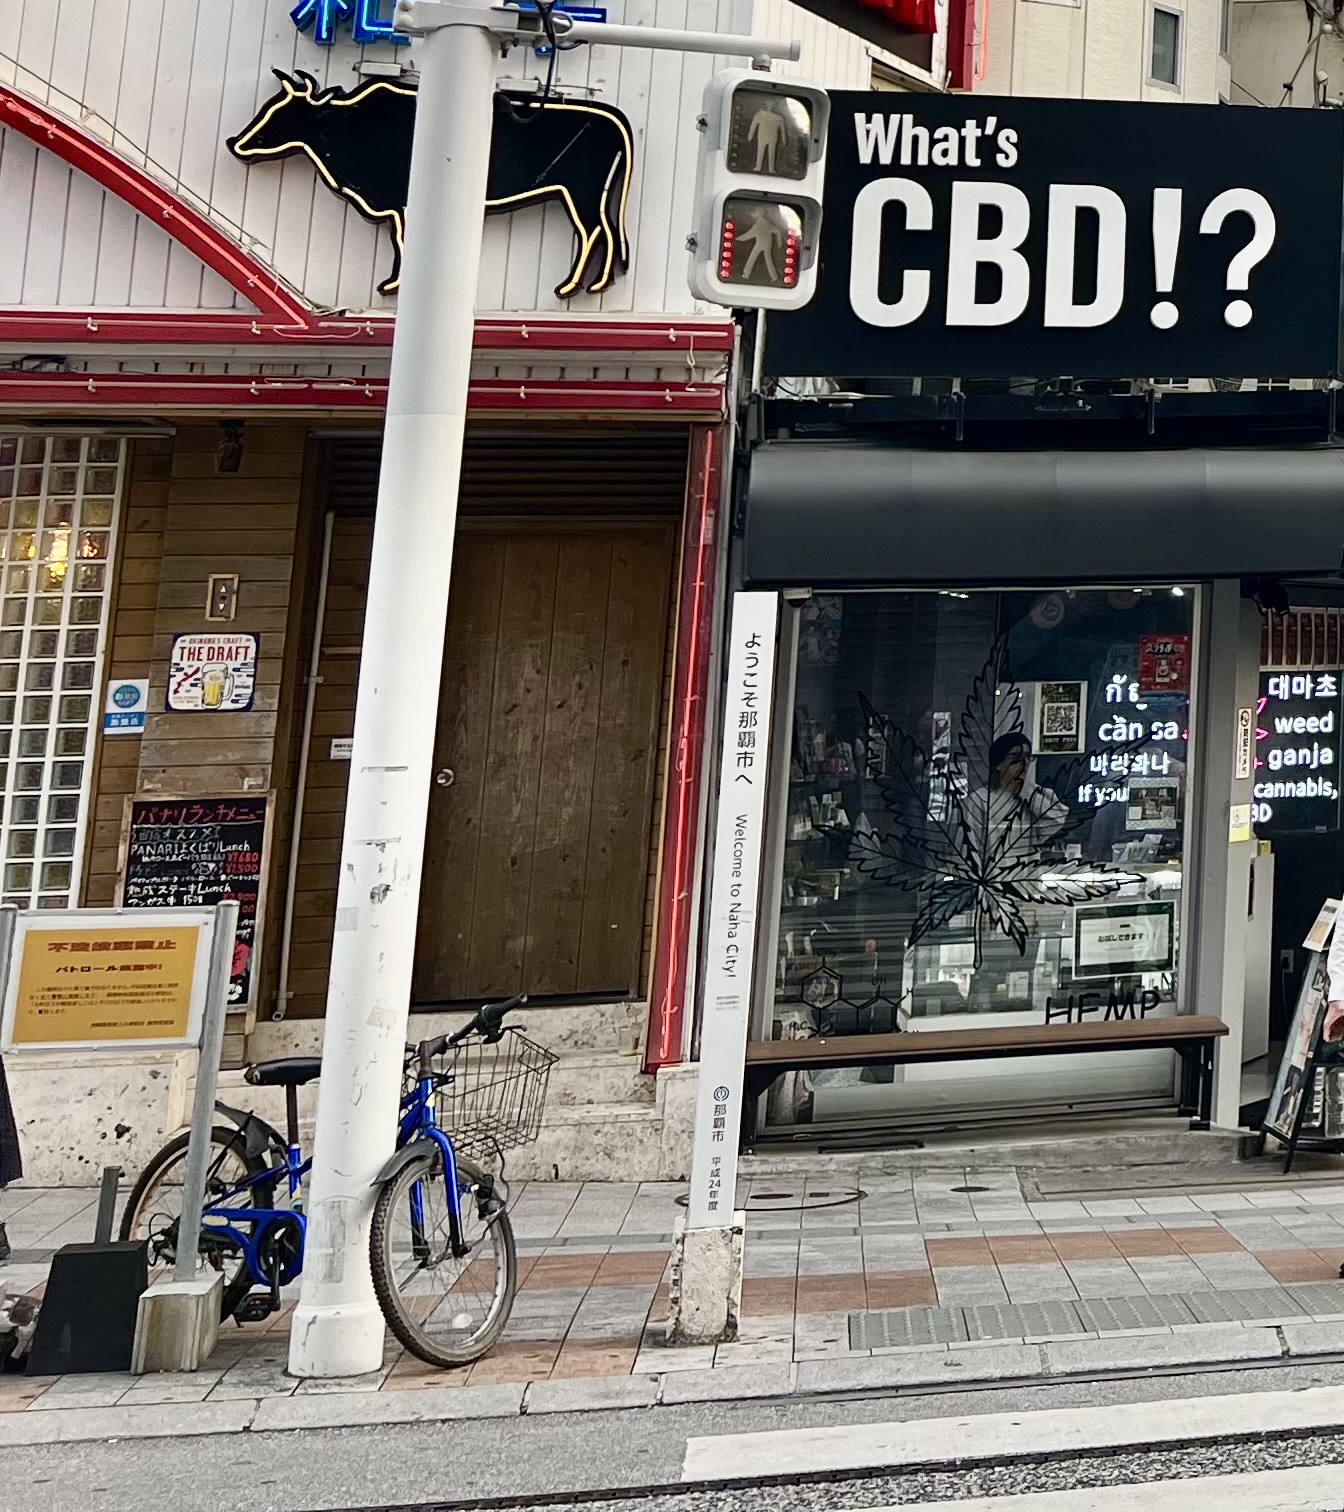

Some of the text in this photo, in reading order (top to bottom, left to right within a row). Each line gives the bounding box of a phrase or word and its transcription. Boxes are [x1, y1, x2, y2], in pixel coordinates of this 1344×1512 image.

[853, 111, 1020, 169] What's
[847, 176, 1280, 331] CBD!?
[179, 645, 252, 663] THE DRAFT
[1267, 673, 1338, 700] 대마초
[735, 632, 762, 785] ようこそ那覇市へ
[1274, 710, 1335, 734] weed
[1150, 720, 1180, 741] sa
[1267, 742, 1334, 772] ganja
[136, 804, 264, 825] パナリランチメニュー
[731, 813, 749, 879] Welcome
[730, 883, 744, 898] to
[726, 902, 742, 940] Naha
[720, 944, 740, 979] City!
[711, 1104, 727, 1143] 那覇市
[707, 1155, 722, 1212] 平成24年度
